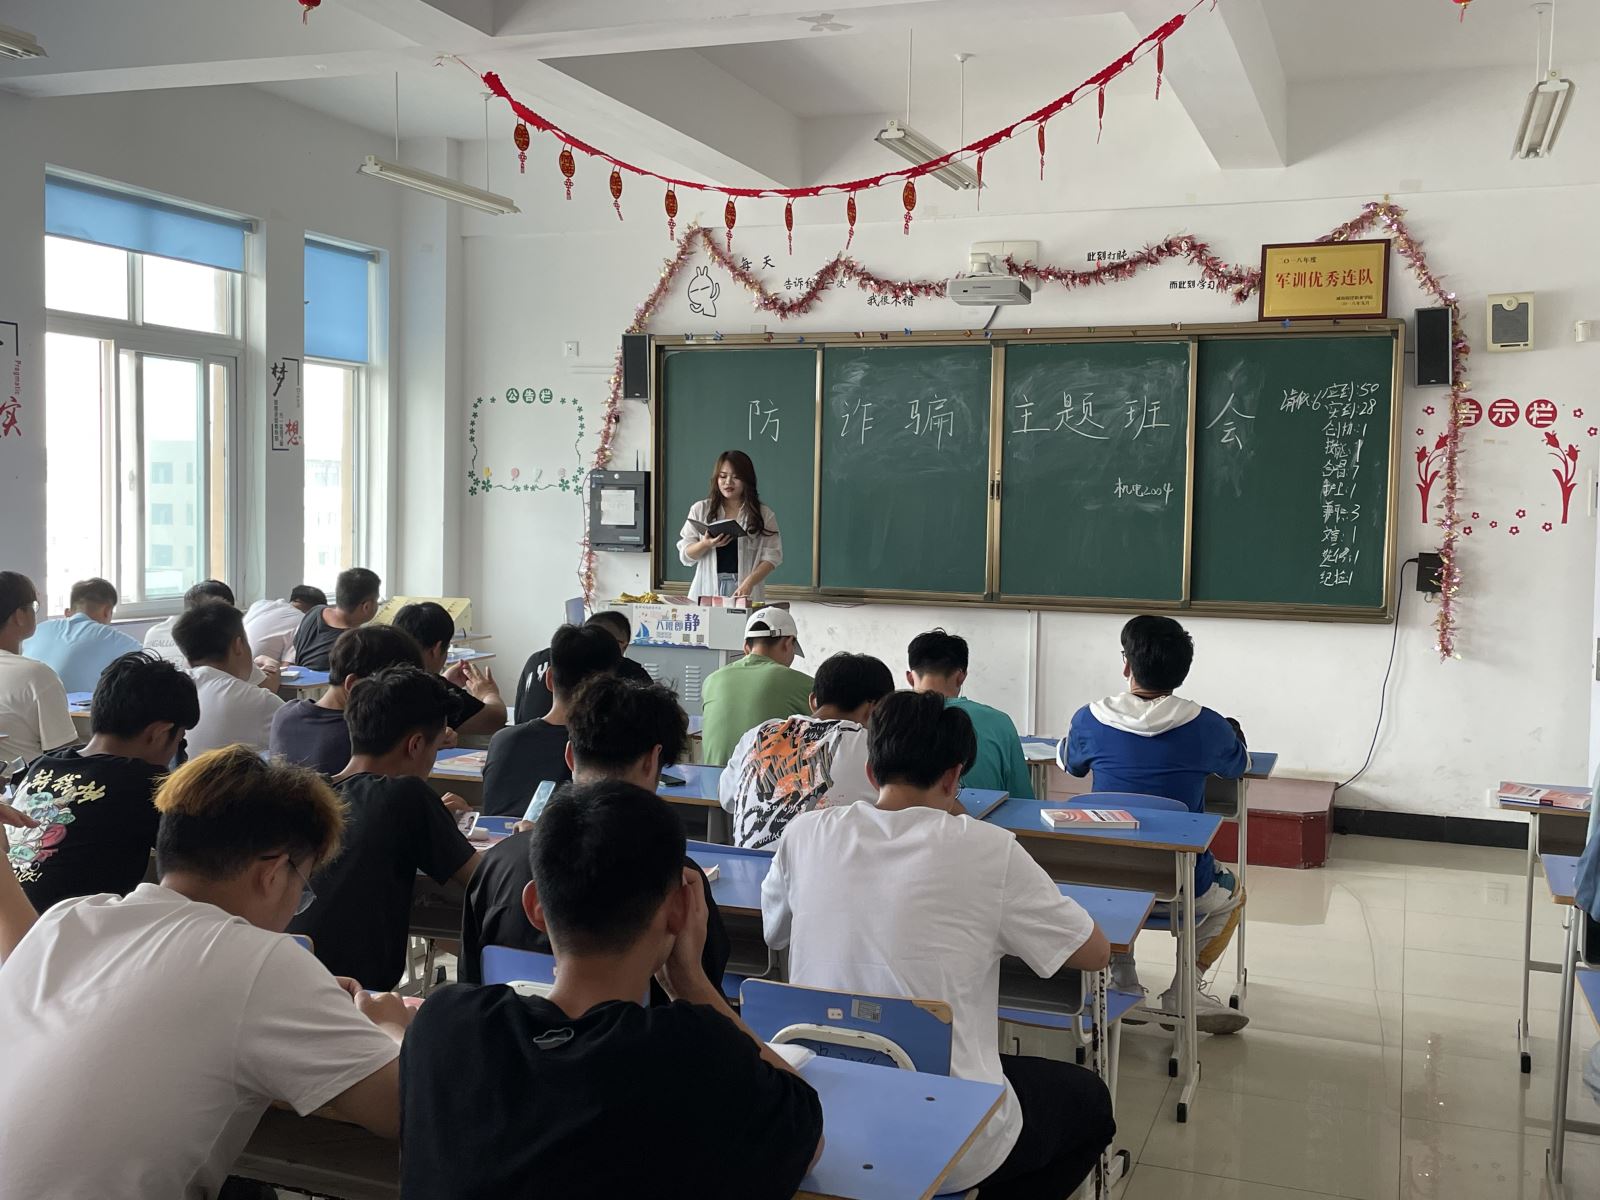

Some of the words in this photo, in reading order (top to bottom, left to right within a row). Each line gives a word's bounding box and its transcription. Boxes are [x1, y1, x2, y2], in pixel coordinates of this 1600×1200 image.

[784, 277, 847, 290] 告诉自一次
[1275, 268, 1374, 289] 军训优秀连队
[270, 362, 288, 397] 梦
[506, 387, 553, 404] 公告栏
[748, 393, 1256, 451] 防诈骗主题班会
